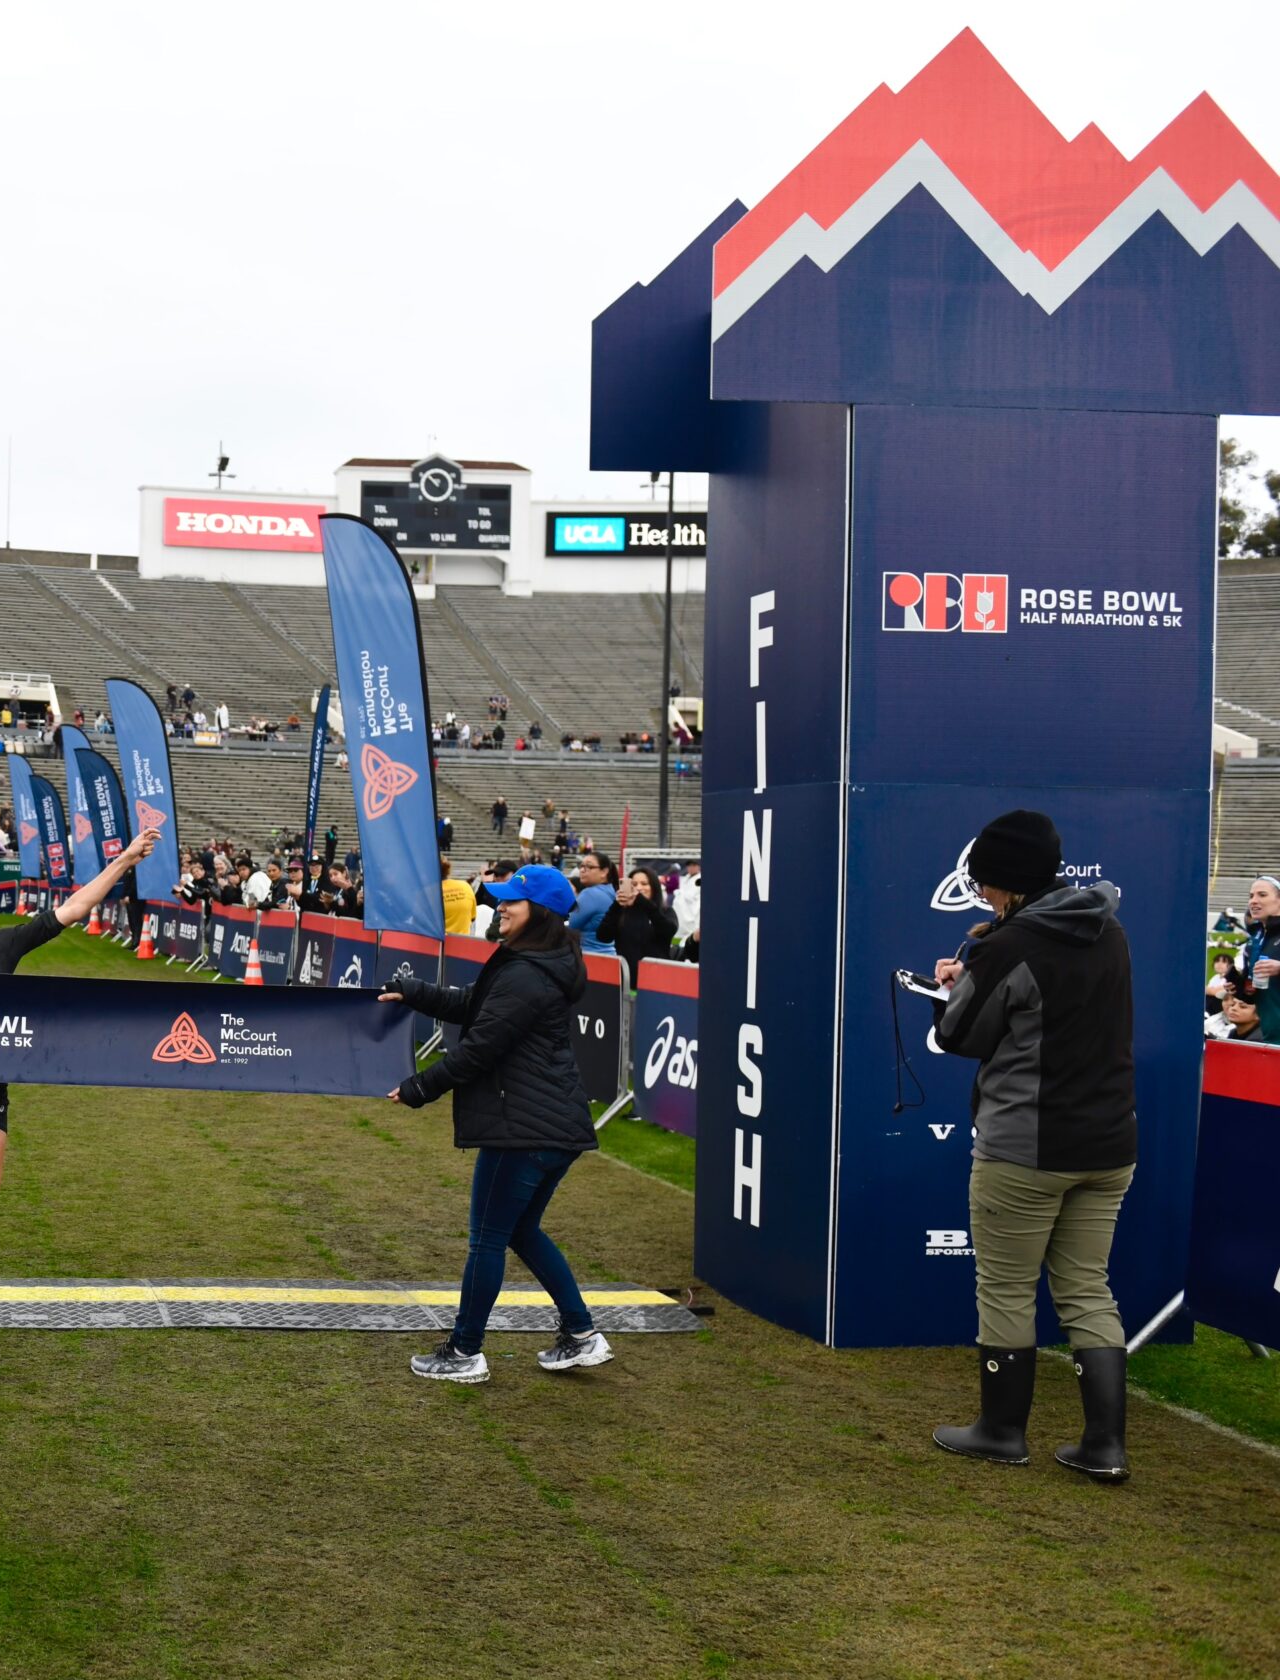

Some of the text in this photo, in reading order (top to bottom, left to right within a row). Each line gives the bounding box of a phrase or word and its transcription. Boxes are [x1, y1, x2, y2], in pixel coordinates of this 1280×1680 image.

[176, 512, 314, 538] HONDA
[373, 518, 398, 528] DOWN
[467, 520, 478, 529] TO
[441, 533, 457, 542] LINE
[478, 534, 510, 544] QUARTER
[563, 524, 617, 544] UCLA
[1020, 588, 1183, 613] ROSE BOWL
[1020, 611, 1183, 628] HALF MARATHON & 5K
[94, 776, 107, 807] BOWL
[101, 808, 113, 837] ROSE
[733, 590, 776, 1228] FINISH
[220, 1013, 245, 1026] The
[0, 1035, 10, 1047] &
[14, 1036, 33, 1048] 5K
[220, 1028, 277, 1042] McCourt
[220, 1043, 292, 1057] Foundation
